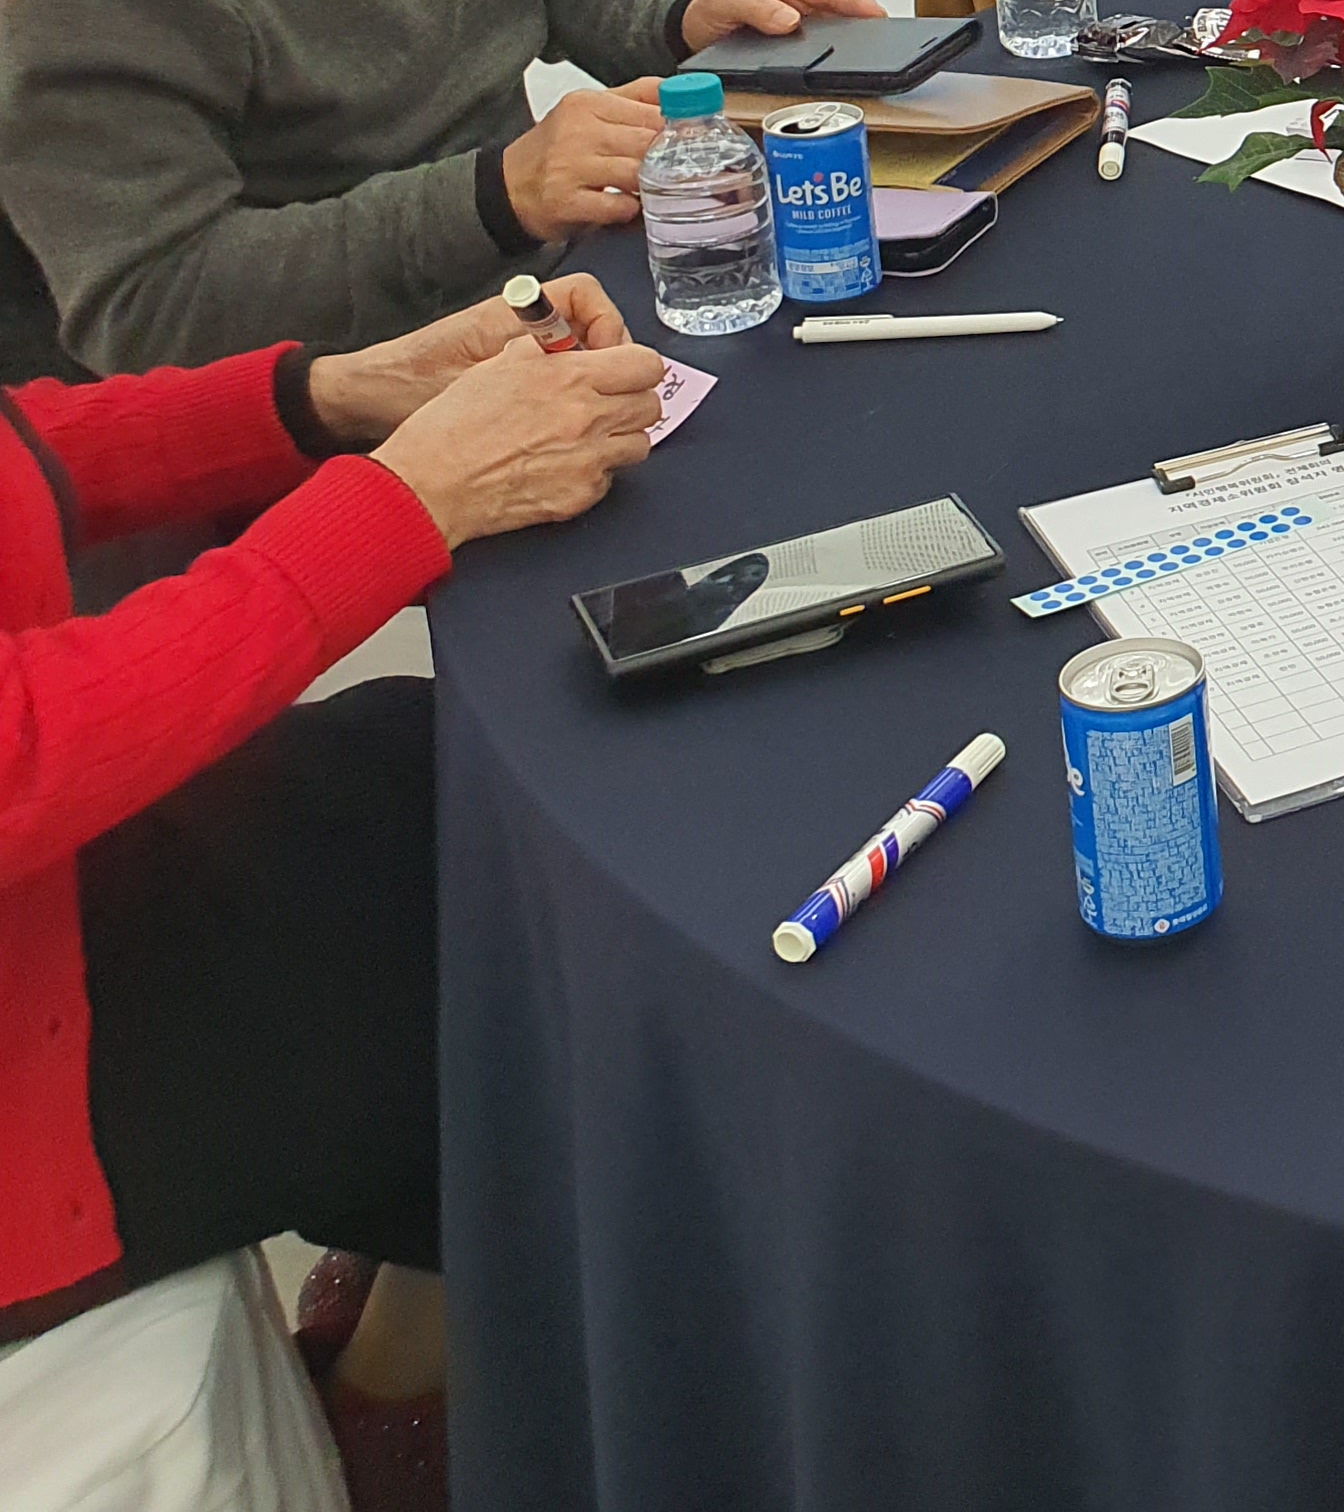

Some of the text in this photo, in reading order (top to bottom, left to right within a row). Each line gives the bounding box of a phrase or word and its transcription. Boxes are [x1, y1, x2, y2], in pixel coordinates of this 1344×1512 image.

[830, 171, 863, 203] Be
[792, 204, 852, 220] MILD COFFEE
[1168, 480, 1282, 514] 지역경제소위원회
[1288, 469, 1328, 486] 참석자
